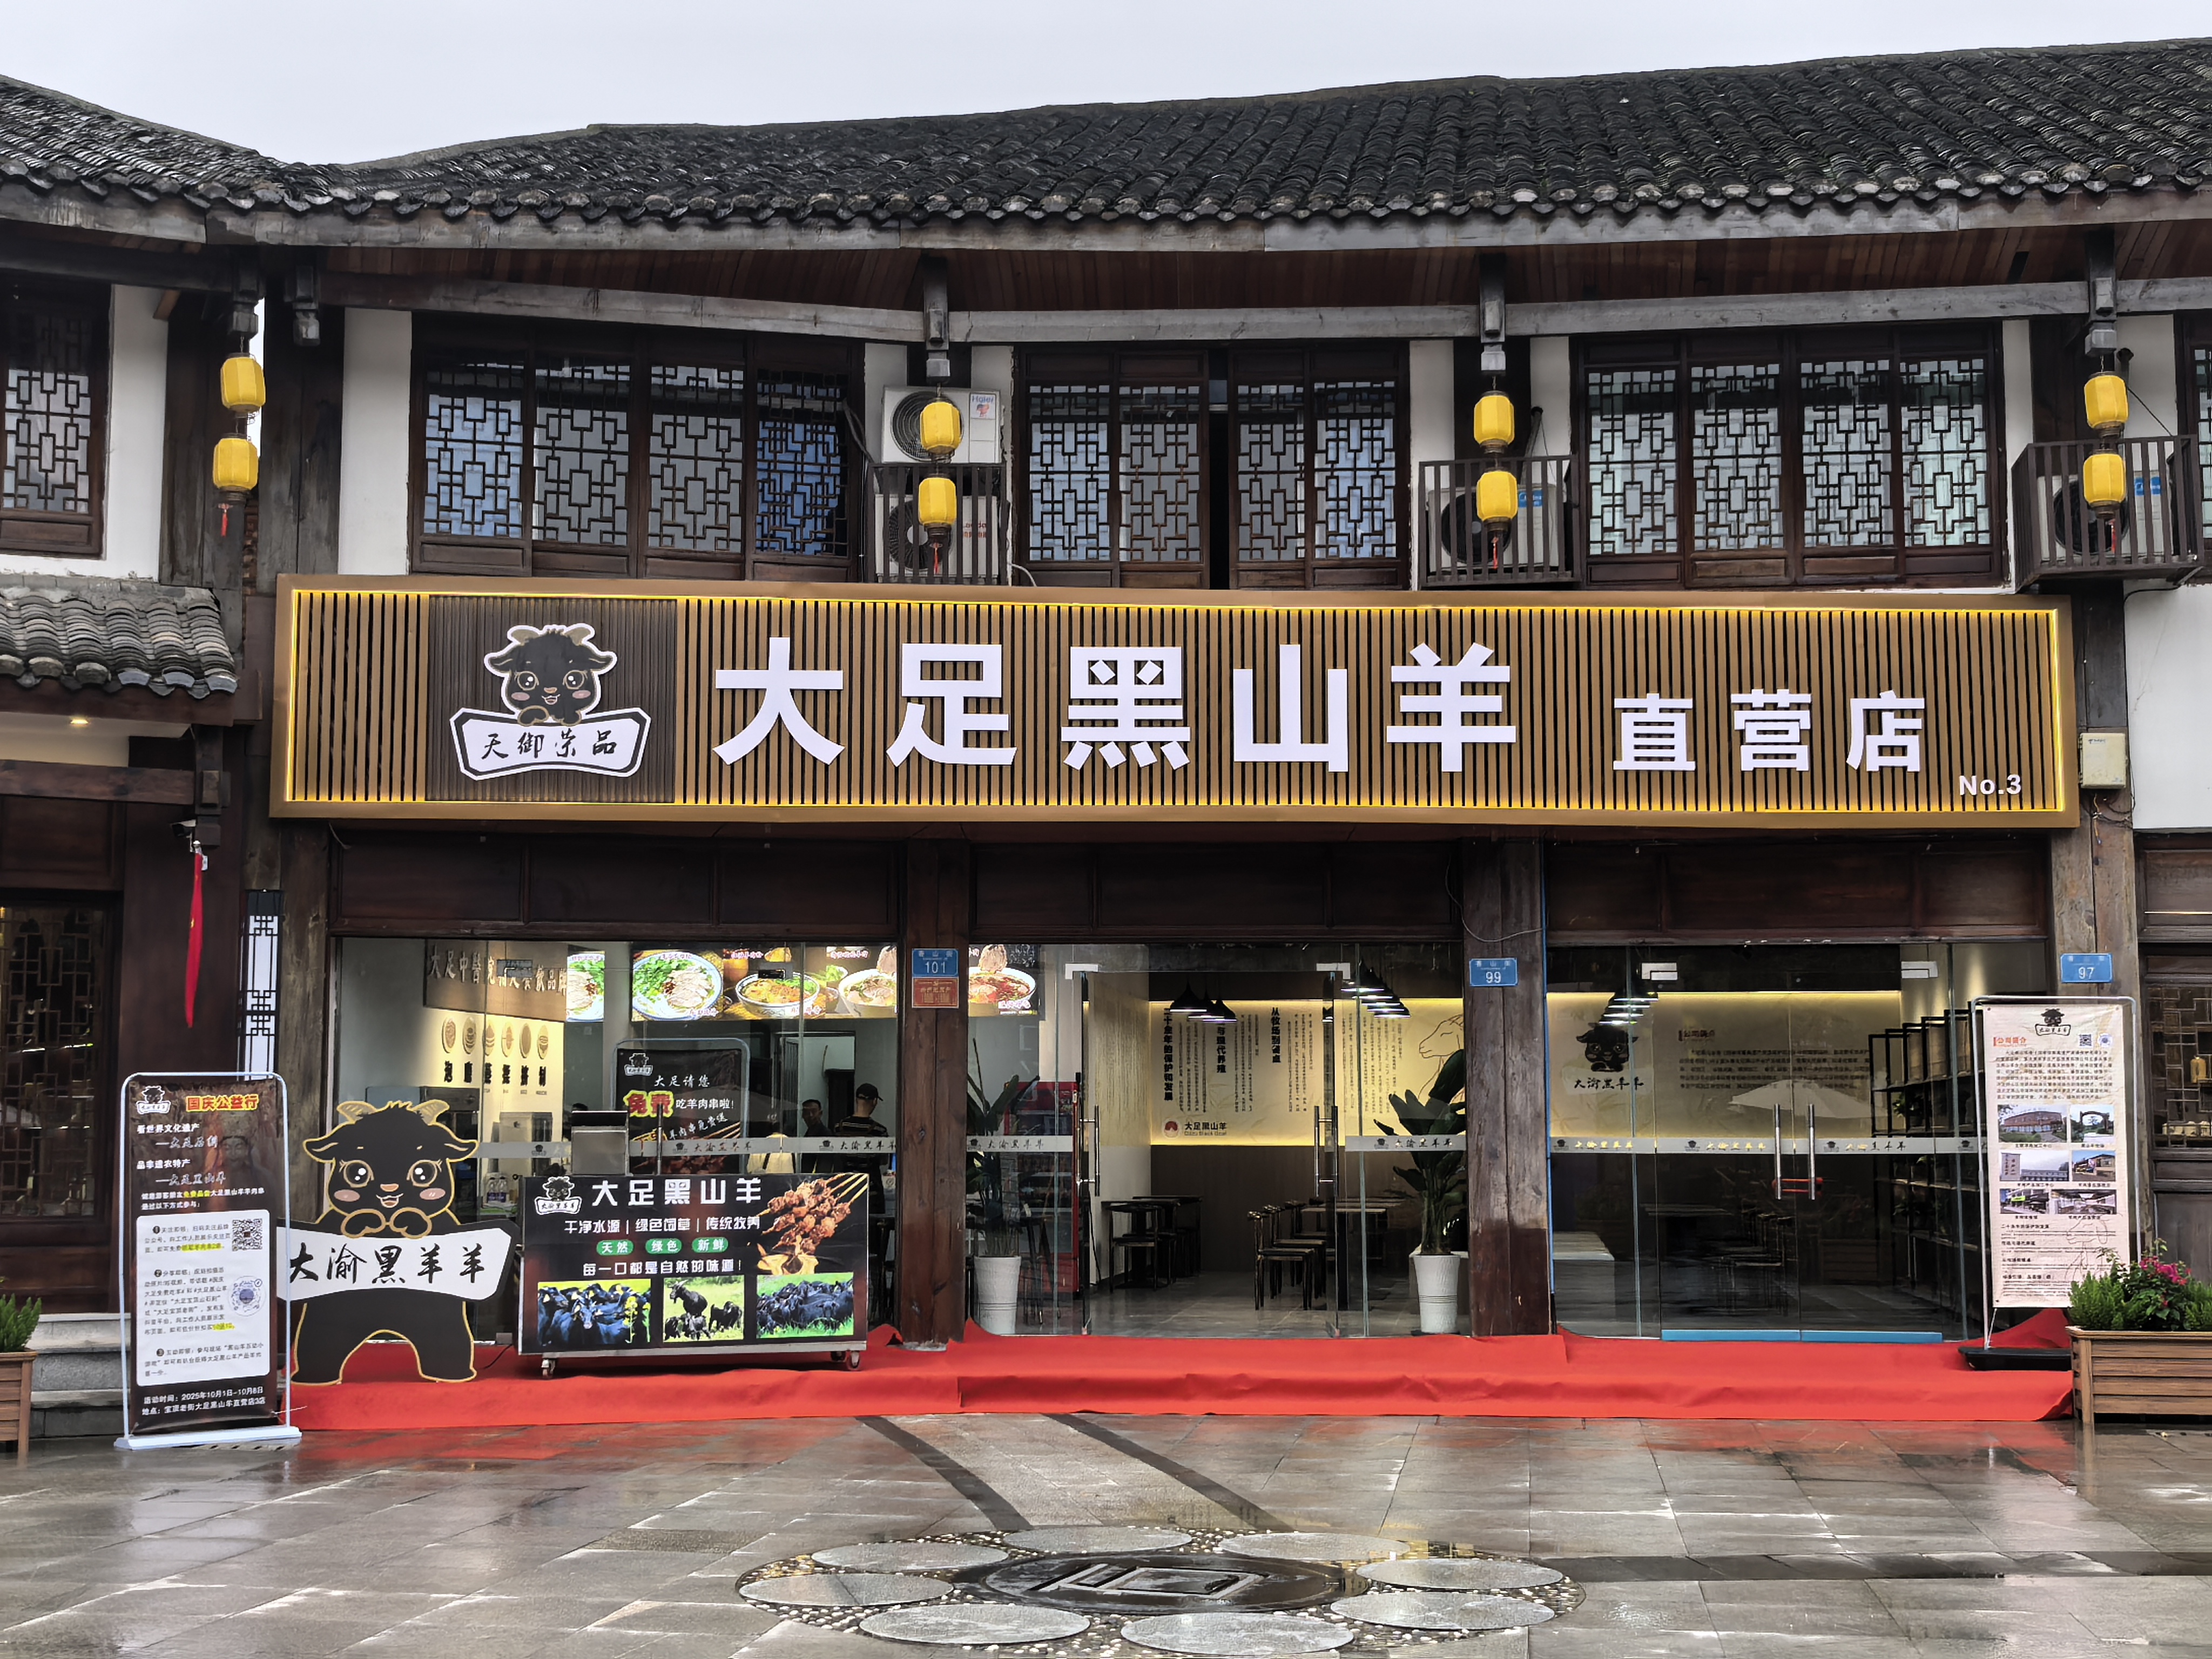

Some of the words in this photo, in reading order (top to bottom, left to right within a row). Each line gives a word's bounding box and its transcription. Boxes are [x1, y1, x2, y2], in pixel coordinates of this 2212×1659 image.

[712, 636, 1517, 773] 大足黑山羊
[1613, 689, 1925, 773] 直营店
[1959, 774, 2021, 795] No.3
[925, 961, 946, 974] 101
[2078, 967, 2094, 980] 97
[1486, 972, 1501, 983] 99
[654, 1074, 711, 1088] 大足请您
[186, 1095, 259, 1111] 国庆公益行
[628, 1093, 672, 1116] 免费
[1184, 1121, 1227, 1130] 大足黑山羊
[592, 1177, 761, 1206] 大足黑山羊
[564, 1219, 621, 1234] 干净水源
[635, 1218, 691, 1232] 绿色饲草
[706, 1216, 760, 1230] 传统牧养
[602, 1242, 629, 1254] 天然
[651, 1240, 679, 1252] 绿色
[697, 1238, 724, 1252] 新鲜
[289, 1242, 485, 1284] 大渝黑羊羊
